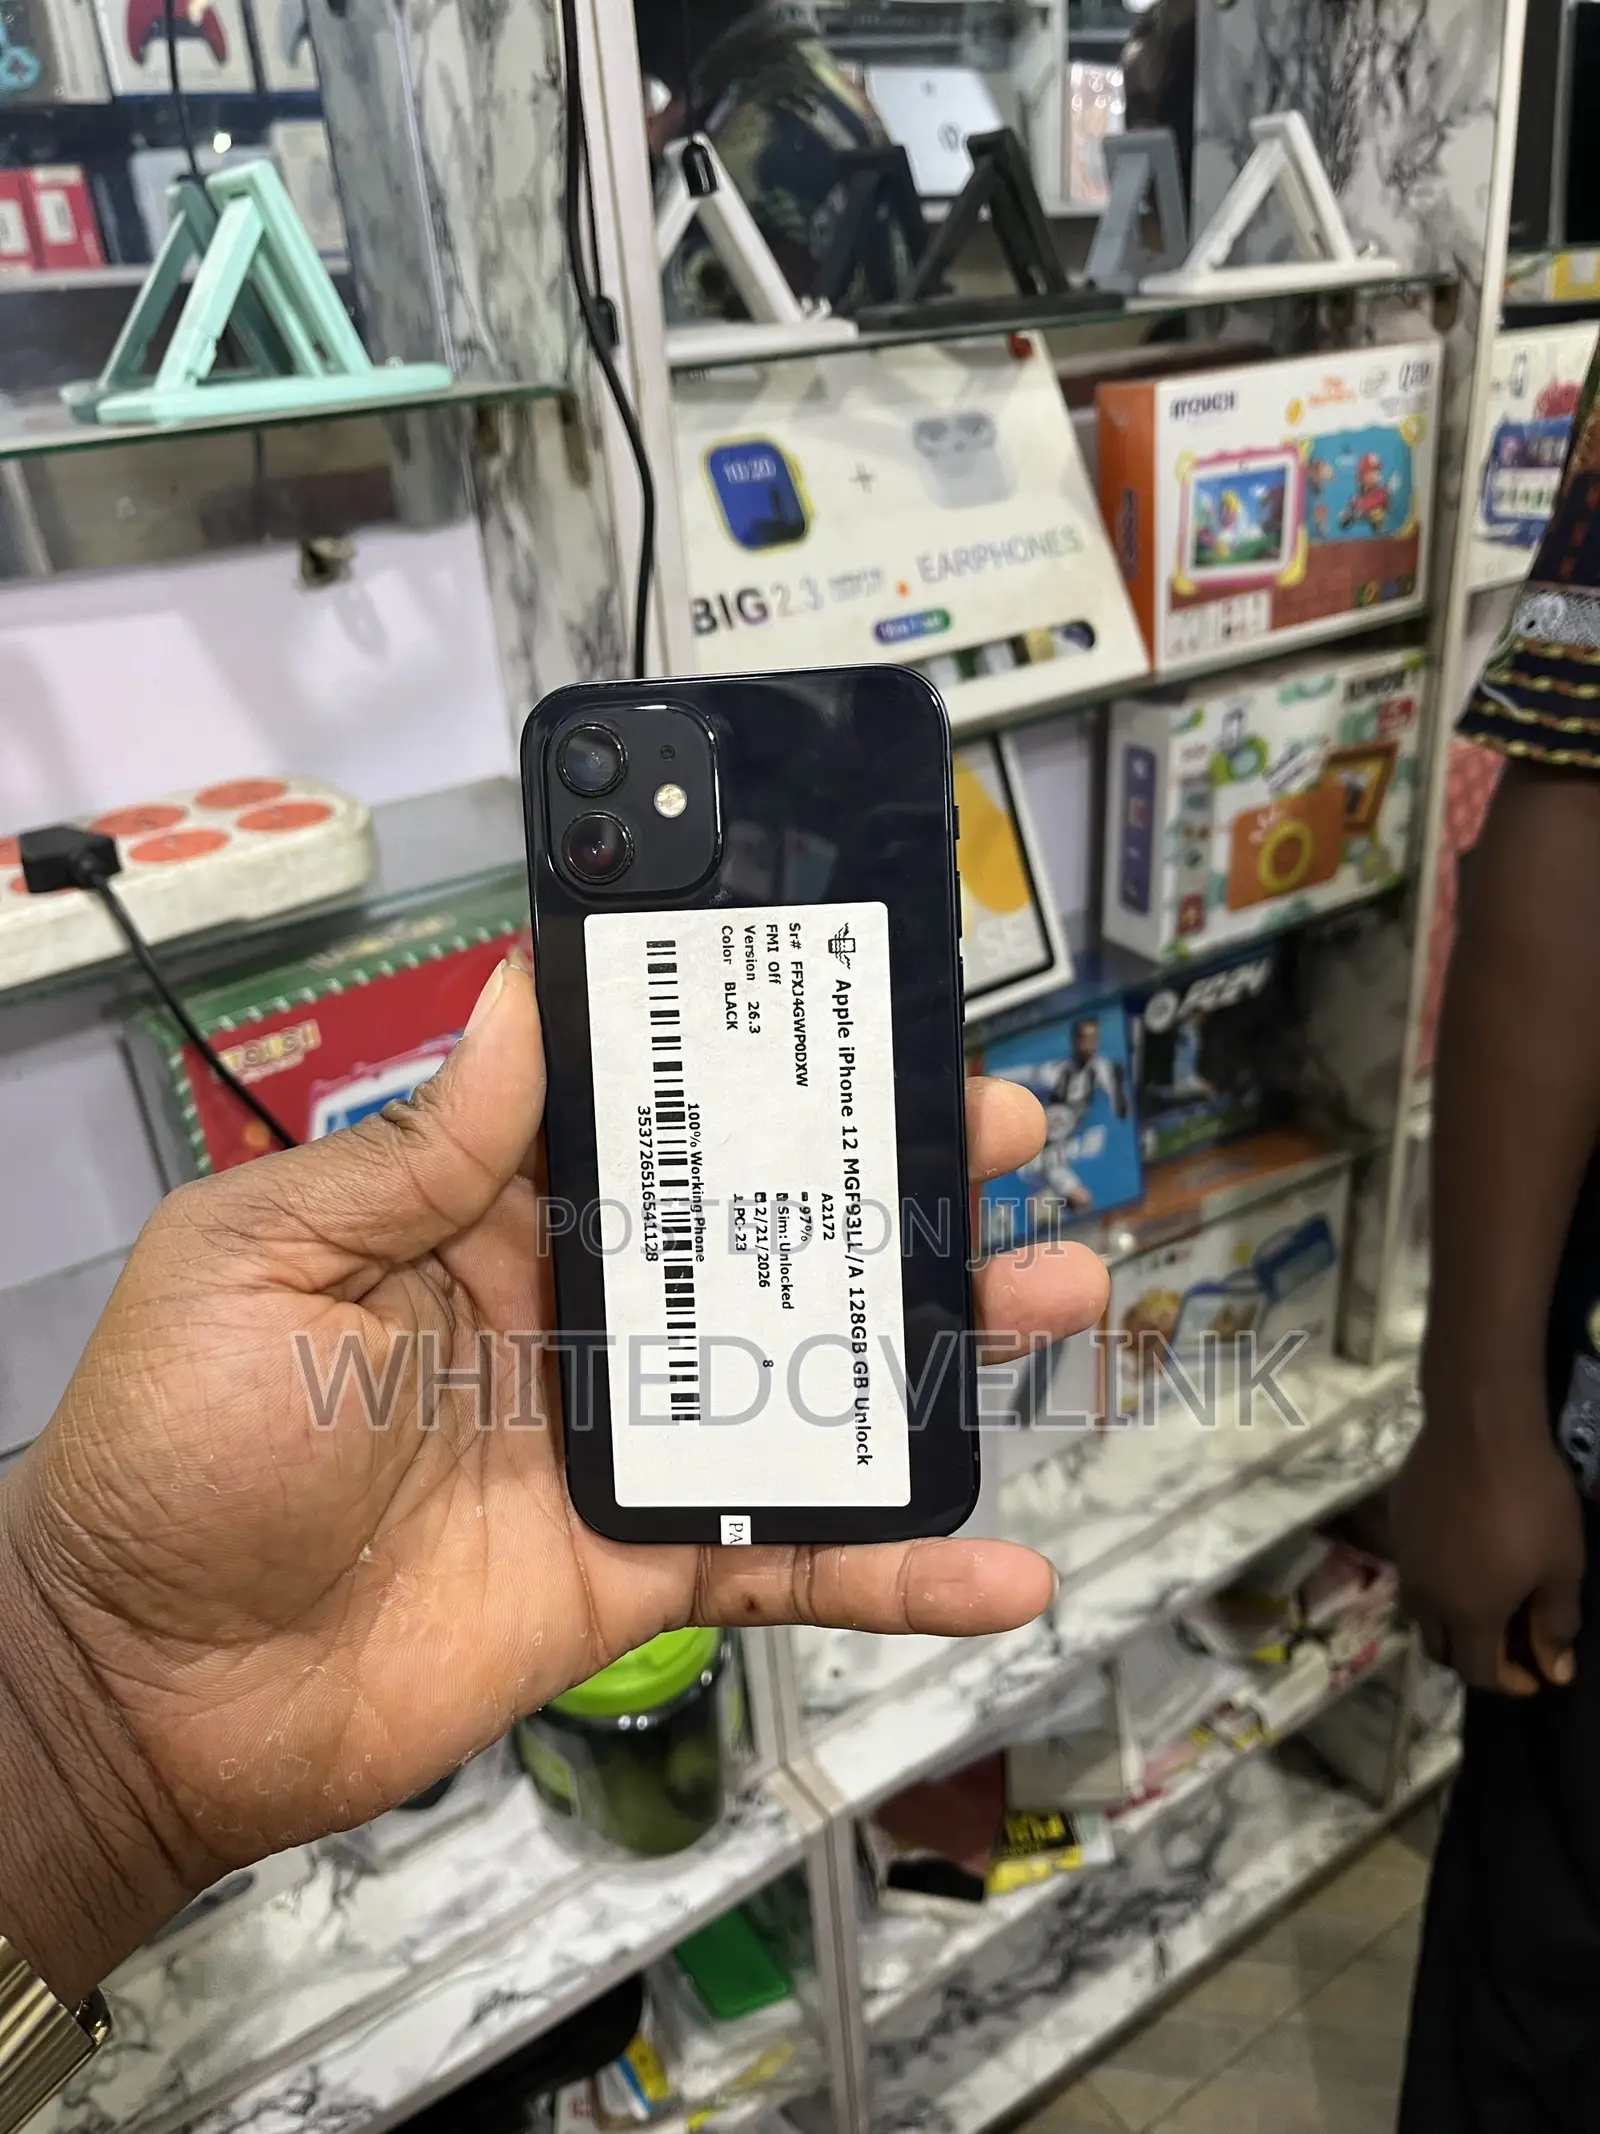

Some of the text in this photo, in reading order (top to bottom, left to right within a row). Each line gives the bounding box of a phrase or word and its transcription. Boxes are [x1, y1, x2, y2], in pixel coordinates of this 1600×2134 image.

[690, 586, 769, 636] BIG
[916, 524, 1085, 584] EARPHONES
[722, 925, 739, 1030] Color BLACK
[744, 925, 761, 1034] Version 26.3
[766, 925, 782, 985] FMI Off
[790, 922, 803, 950] Sr#
[637, 1105, 660, 1262] 353726516541128
[687, 1103, 708, 1262] 100% Working Phone
[800, 1206, 812, 1241] 97%
[822, 1193, 836, 1240] A2172
[832, 980, 873, 1466] Apple iPhone 12 MGF93LL/A 128GB GB Unlock
[733, 1207, 748, 1251] PC-23
[755, 1207, 770, 1287] 2/21/2026
[778, 1206, 795, 1309] Sim: Unlocked
[762, 1359, 774, 1368] 8
